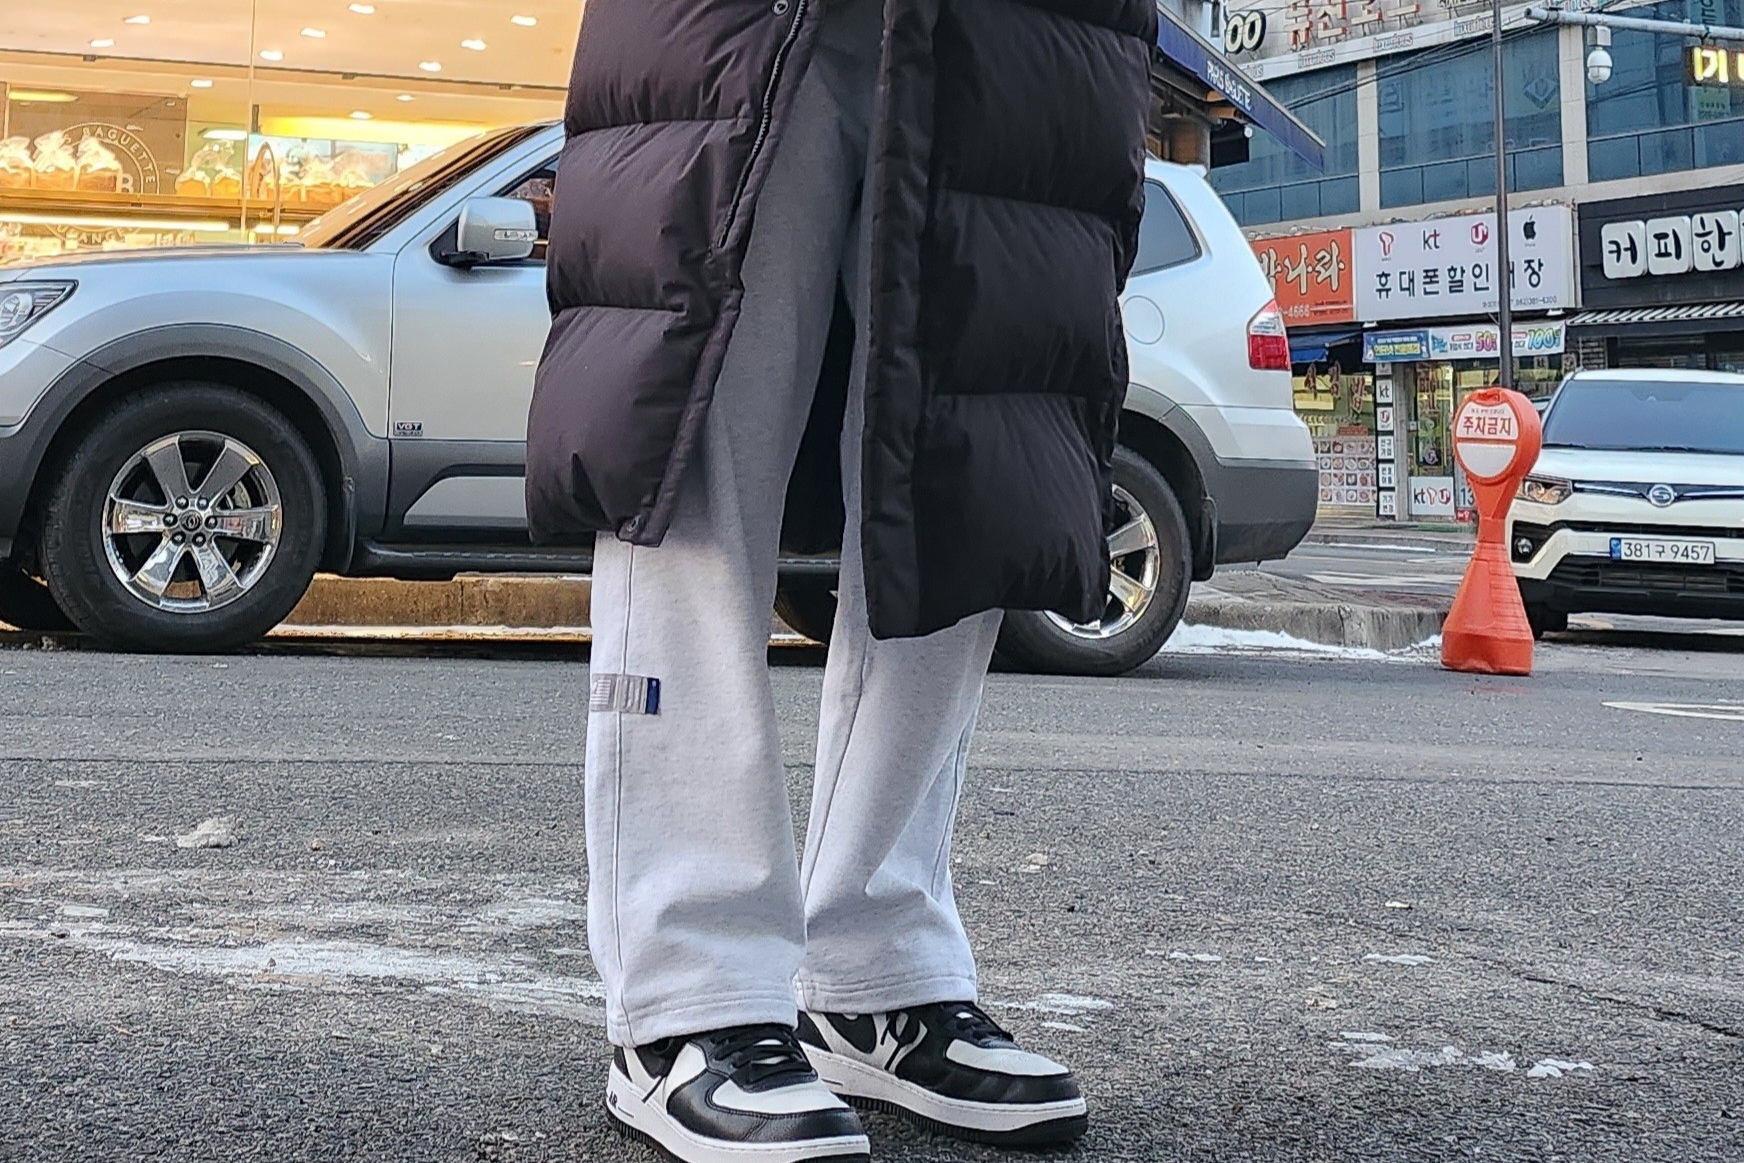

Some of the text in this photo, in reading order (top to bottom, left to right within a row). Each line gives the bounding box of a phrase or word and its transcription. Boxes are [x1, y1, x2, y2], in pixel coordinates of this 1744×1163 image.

[1607, 216, 1744, 268] 커피한
[1463, 416, 1511, 436] 주차금지
[1623, 542, 1710, 561] 381구 9457
